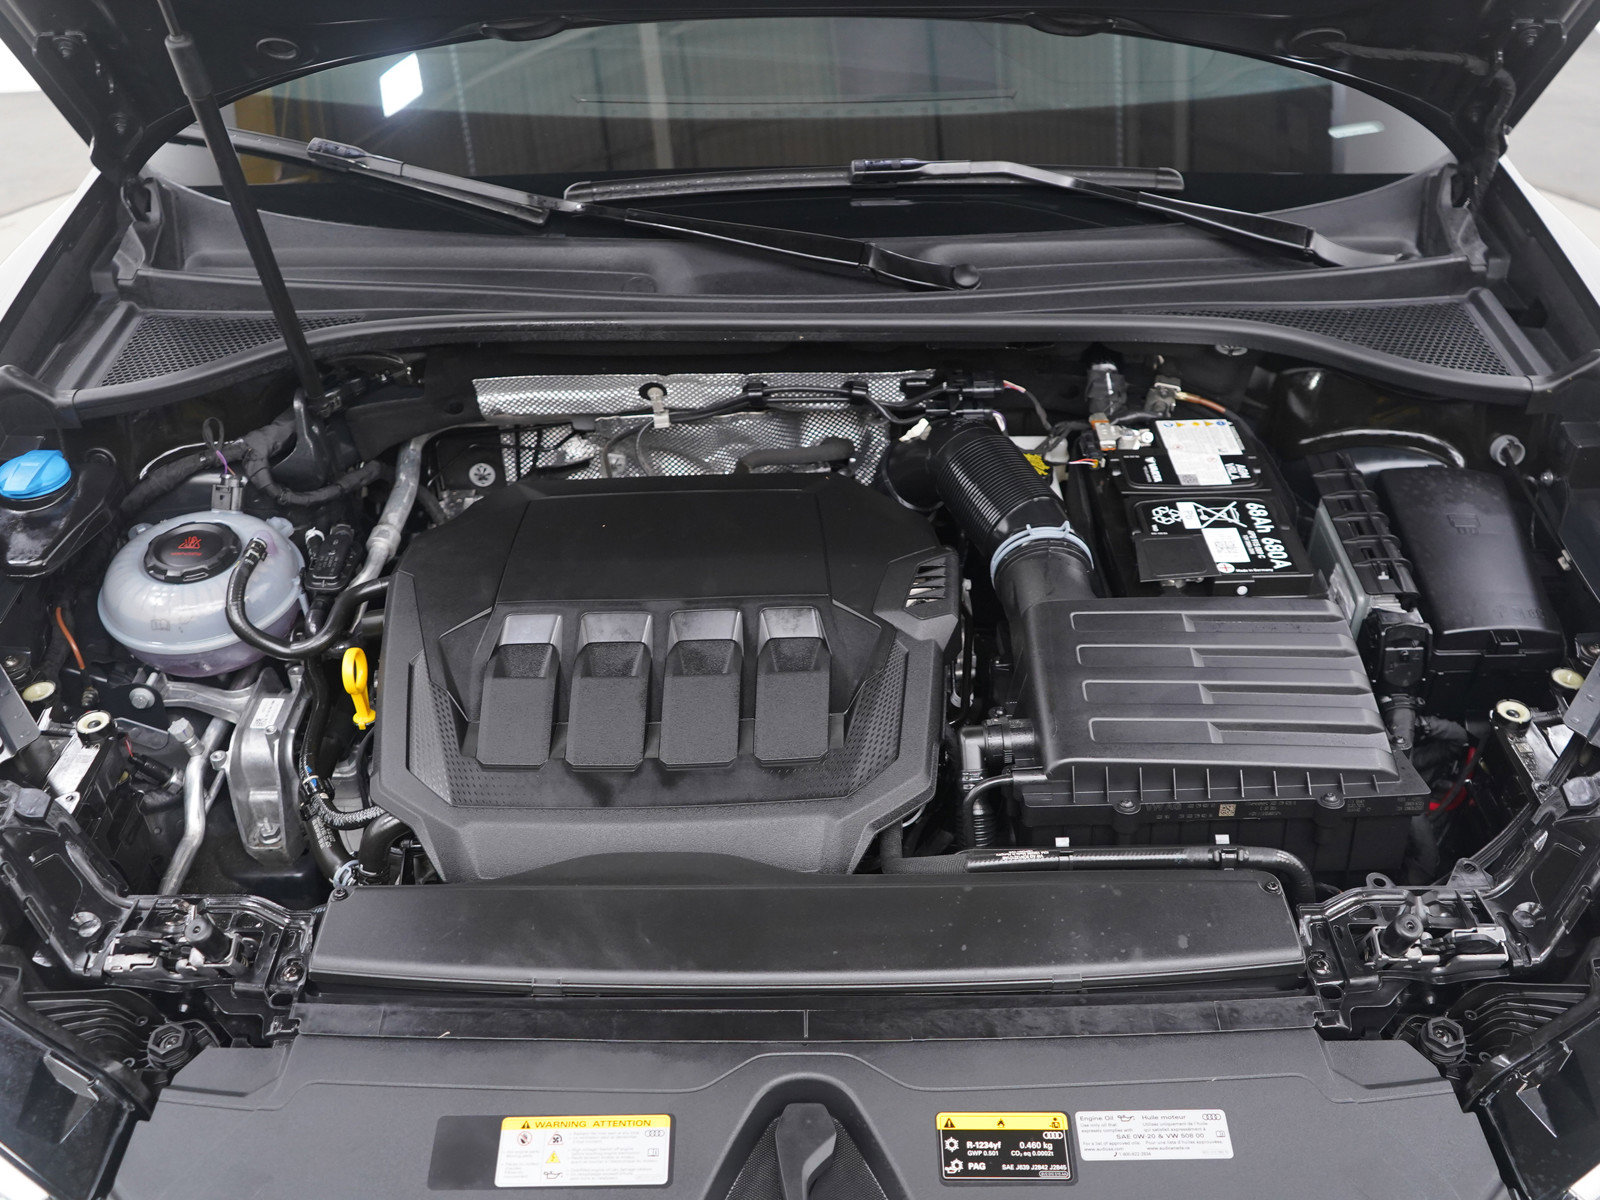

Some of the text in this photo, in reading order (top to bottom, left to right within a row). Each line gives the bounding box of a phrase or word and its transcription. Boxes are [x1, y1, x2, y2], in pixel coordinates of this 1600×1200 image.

[1245, 502, 1275, 534] 68Ah
[1261, 536, 1292, 570] 680A
[534, 1118, 652, 1129] WARNING ATTENTION
[966, 1141, 1053, 1150] R-1234yf 0.460 kg
[968, 1162, 986, 1170] PAG
